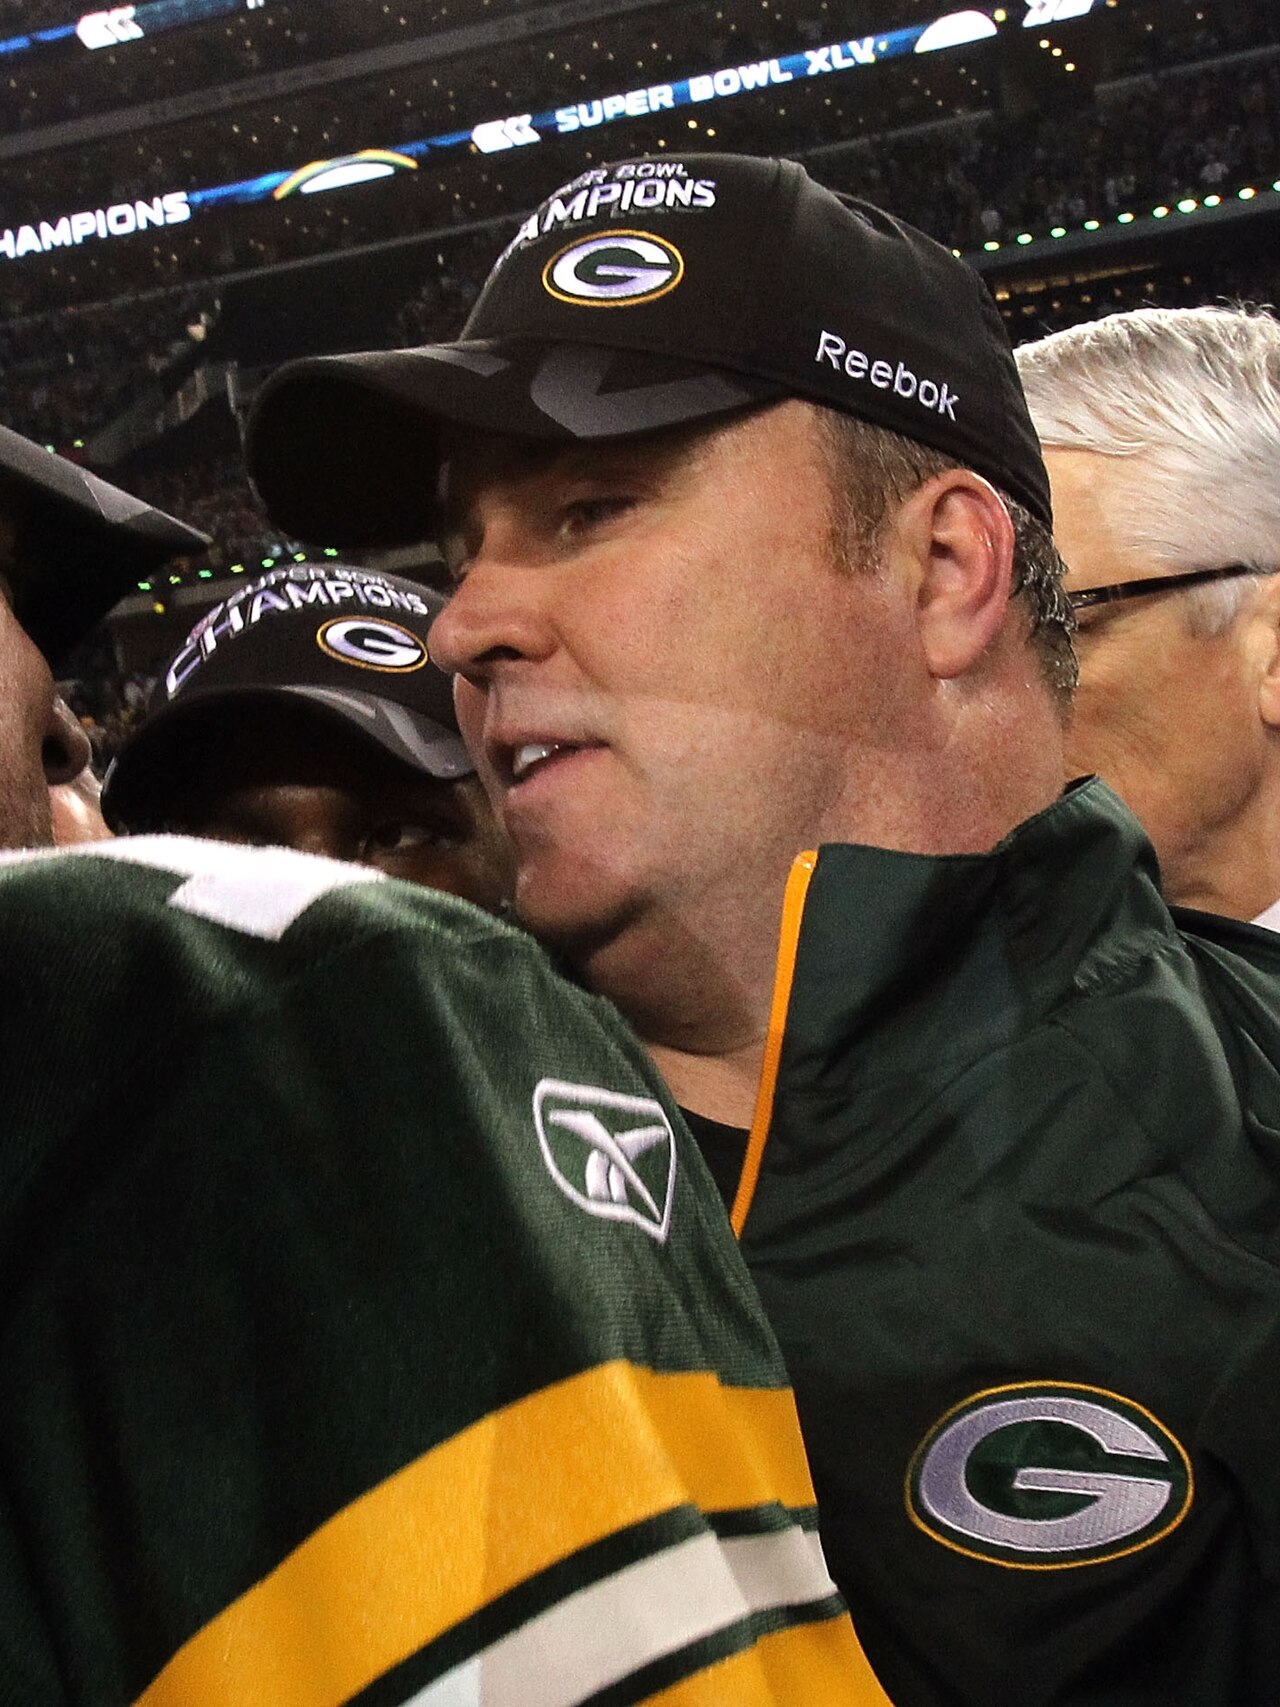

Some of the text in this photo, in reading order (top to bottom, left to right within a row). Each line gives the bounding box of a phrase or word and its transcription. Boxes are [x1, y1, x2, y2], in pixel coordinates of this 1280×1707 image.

[554, 36, 875, 133] SUPER BOWL XLV
[815, 329, 960, 422] Reebok
